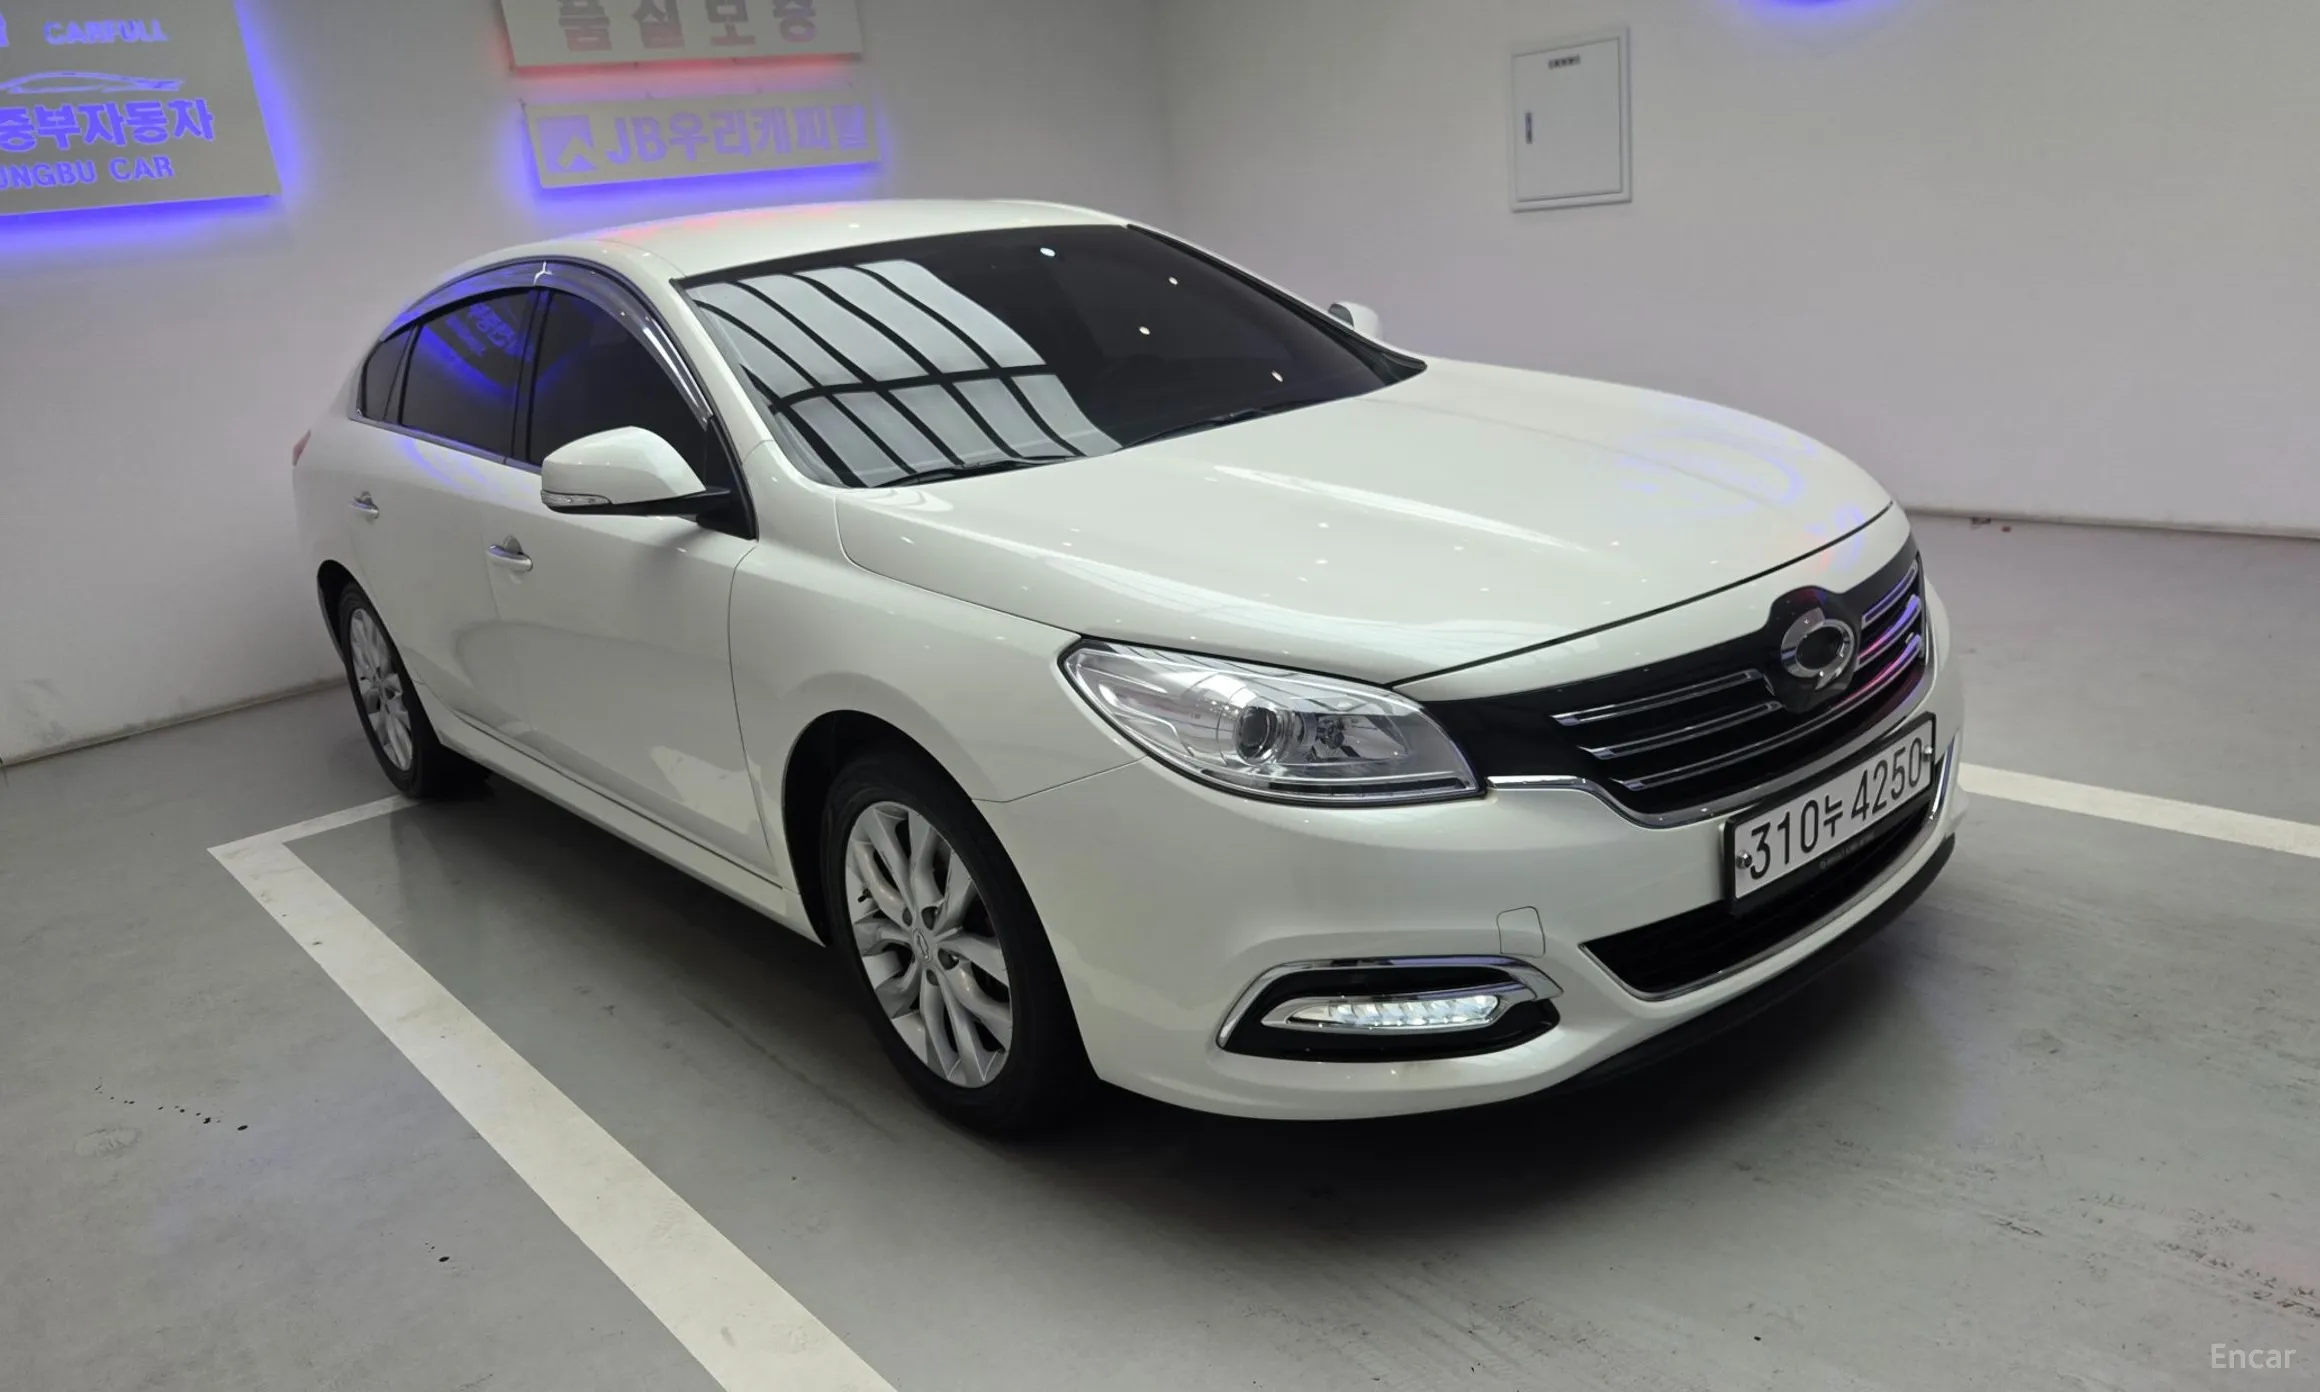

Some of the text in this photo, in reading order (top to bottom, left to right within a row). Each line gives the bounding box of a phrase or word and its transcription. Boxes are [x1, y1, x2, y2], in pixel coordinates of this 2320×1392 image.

[0, 98, 215, 152] 중부자동차
[109, 155, 175, 181] CAR
[1750, 795, 1843, 880] 310누
[1851, 737, 1923, 821] 4250
